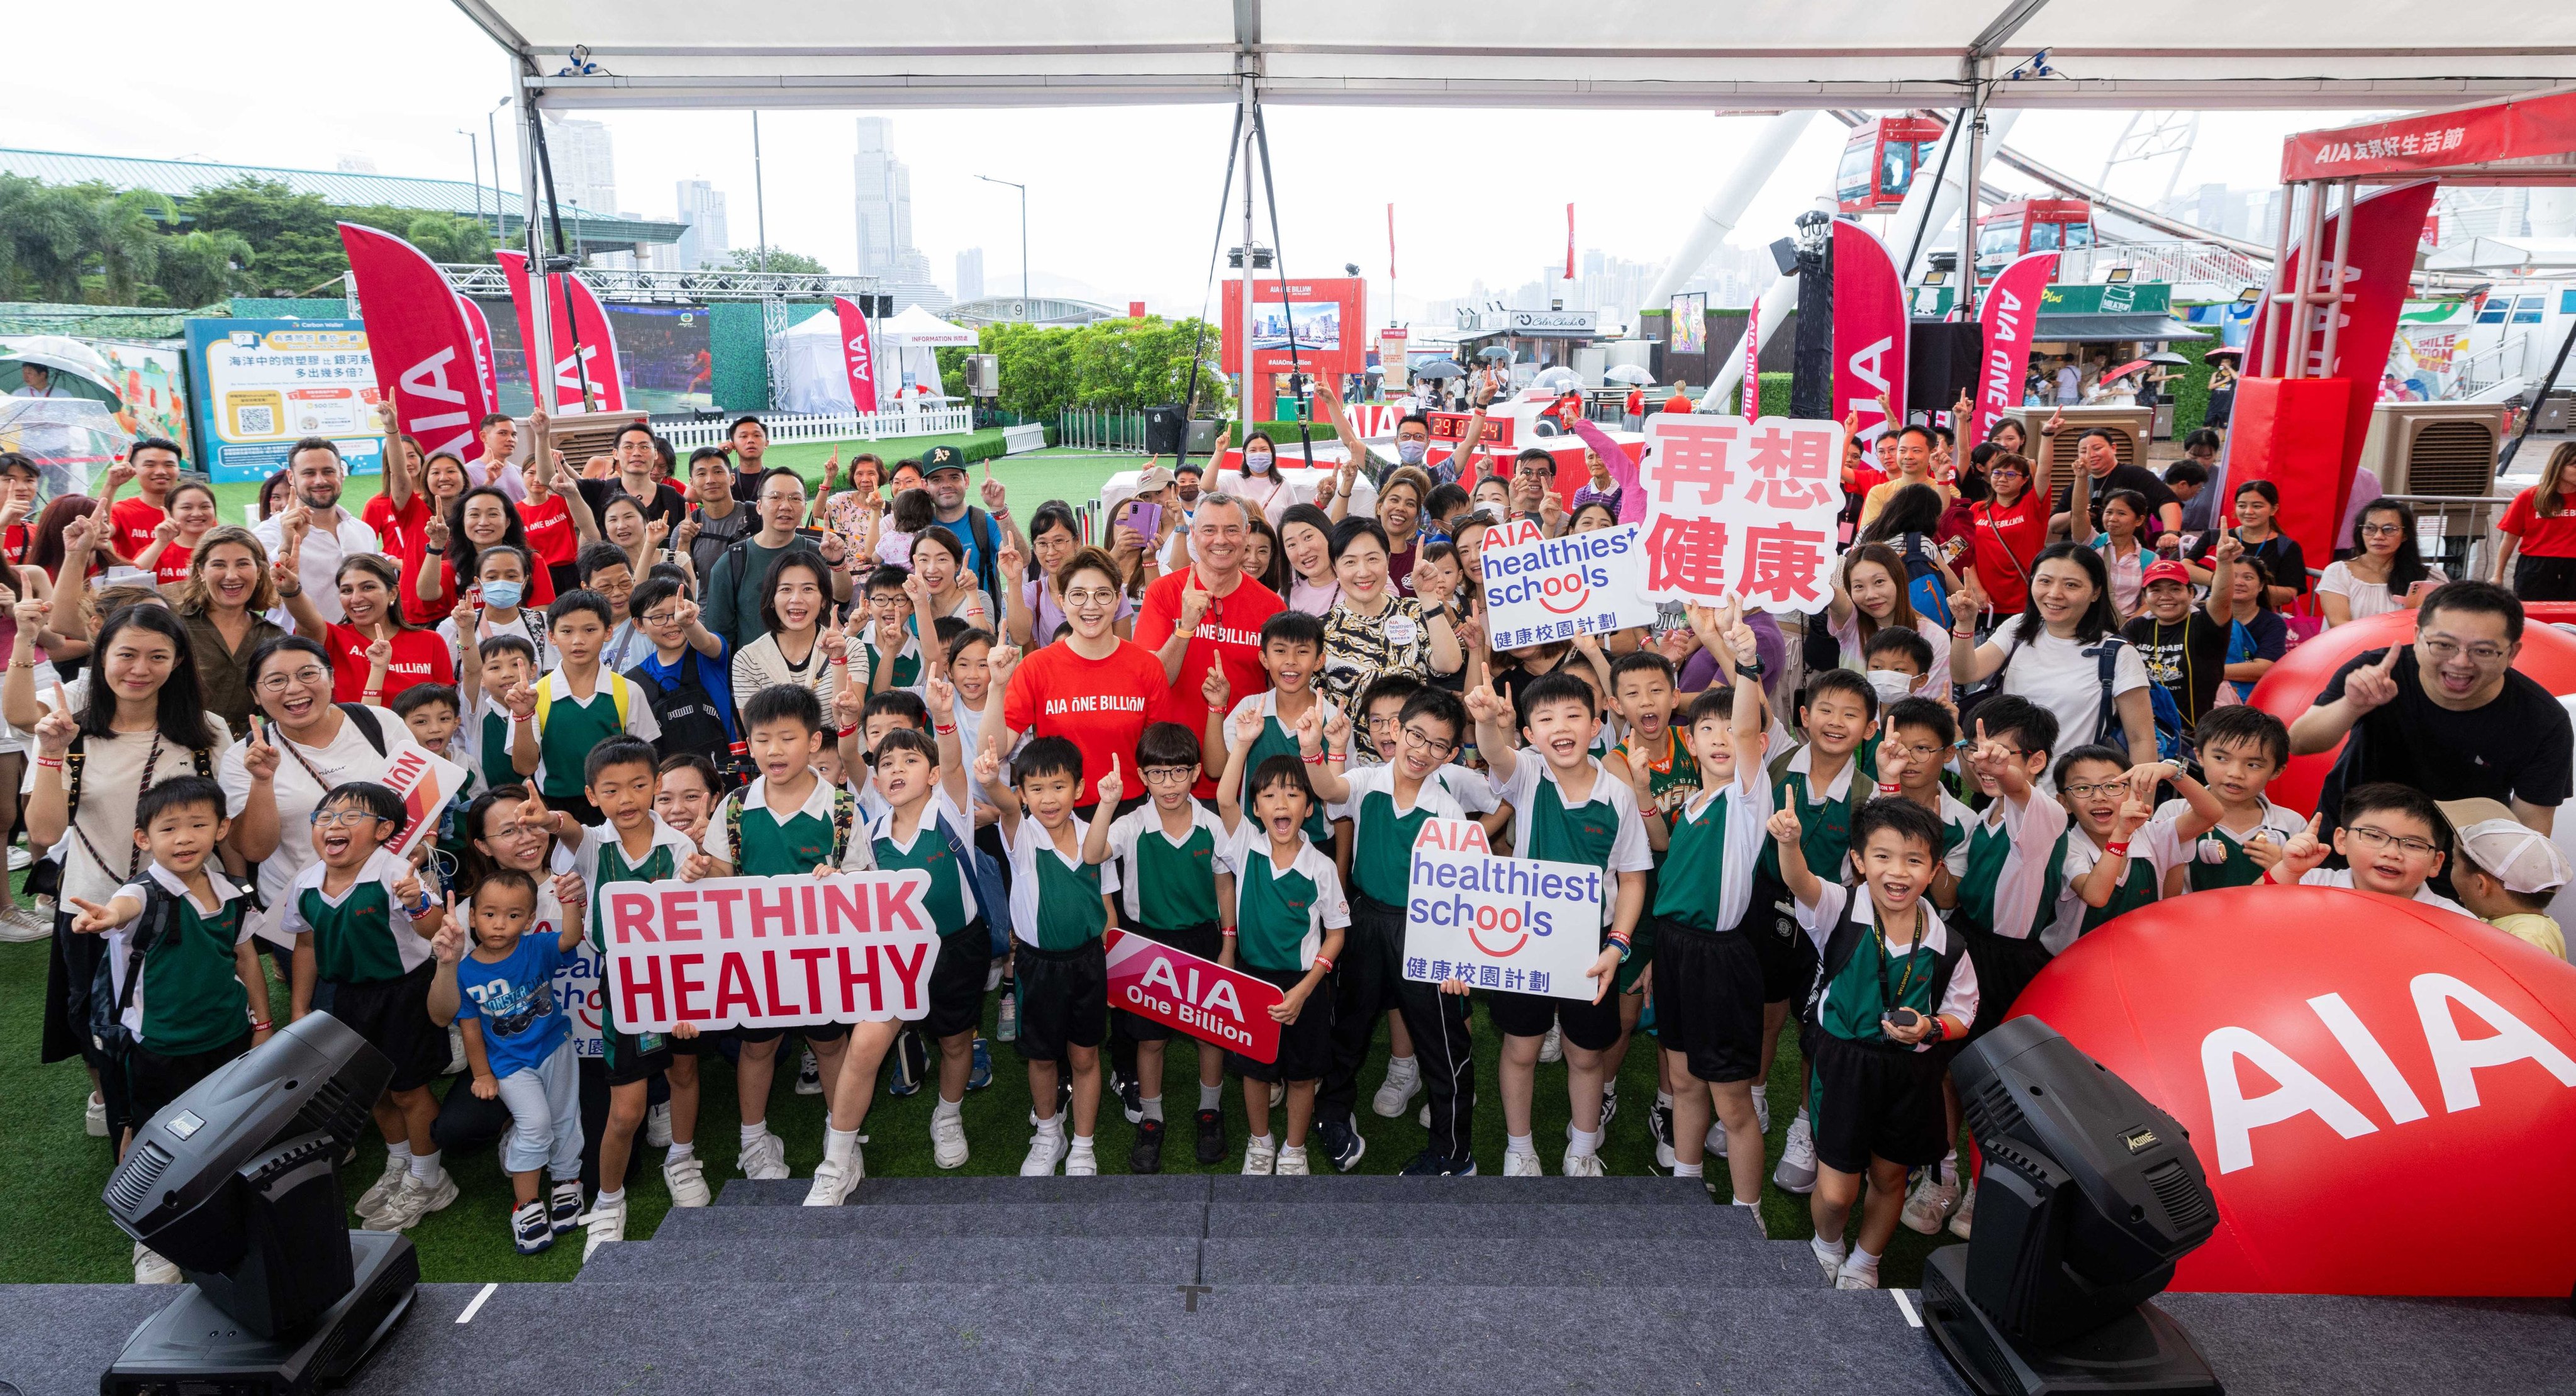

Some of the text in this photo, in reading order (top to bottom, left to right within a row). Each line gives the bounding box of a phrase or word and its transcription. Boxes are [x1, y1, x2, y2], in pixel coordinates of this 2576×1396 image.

[2314, 127, 2466, 165] AIA 友邦好生活節
[1015, 304, 1022, 316] 9
[1553, 317, 1578, 326] Chacha
[1995, 288, 2022, 342] AIA
[1748, 319, 1756, 348] AIA
[2419, 334, 2456, 347] SMILE
[230, 356, 320, 366] 海洋中的微塑膠
[334, 355, 371, 365] 銀河系
[295, 368, 363, 378] 多出幾多倍?
[848, 333, 870, 383] AIA
[1342, 405, 1398, 438] AIA
[1433, 418, 1451, 435] 29
[932, 448, 951, 464] A's
[1651, 424, 1832, 510] 再想
[131, 528, 149, 539] AIA
[1483, 522, 1543, 551] AIA
[1975, 518, 1988, 527] AIA
[1483, 528, 1638, 579] healthiest
[1645, 513, 1826, 602] 健康
[1488, 564, 1609, 607] schools
[1494, 611, 1618, 649] 健康校園計劃
[667, 705, 694, 720] PUMA
[1045, 699, 1068, 715] AIA
[1415, 820, 1489, 854] AIA
[1412, 852, 1600, 903] healthiest
[611, 881, 923, 944] RETHINK
[1409, 893, 1553, 937] schools
[618, 943, 928, 1024] HEALTHY
[1140, 956, 1245, 1023] AIA
[1407, 956, 1550, 993] 健康校園計劃
[1897, 970, 1910, 996] GONGTIAN
[1126, 985, 1252, 1047] One Billion
[2200, 973, 2576, 1175] AIA
